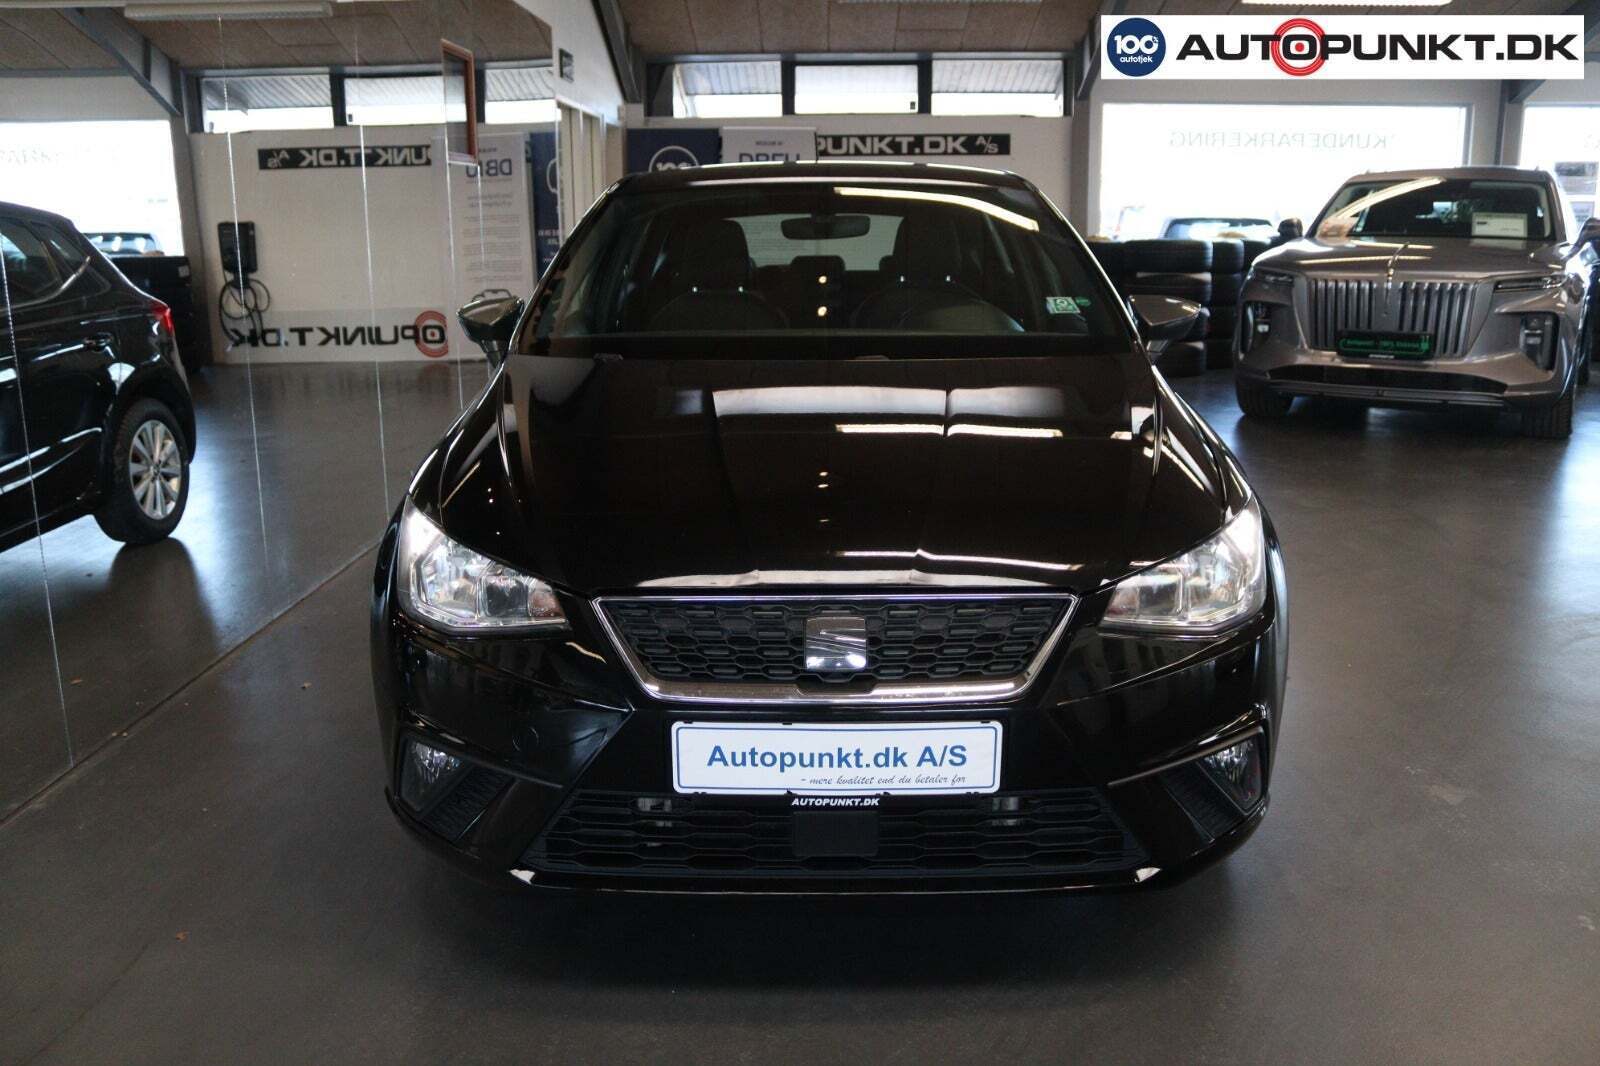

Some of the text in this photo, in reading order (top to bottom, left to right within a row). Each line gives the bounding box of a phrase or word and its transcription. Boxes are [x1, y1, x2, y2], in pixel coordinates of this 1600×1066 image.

[975, 135, 999, 154] A/S
[707, 744, 967, 772] Autopunkt.dk A/S
[836, 774, 874, 785] kvalitet
[898, 775, 911, 784] du
[791, 797, 880, 807] AUTOPUNKT.DK
